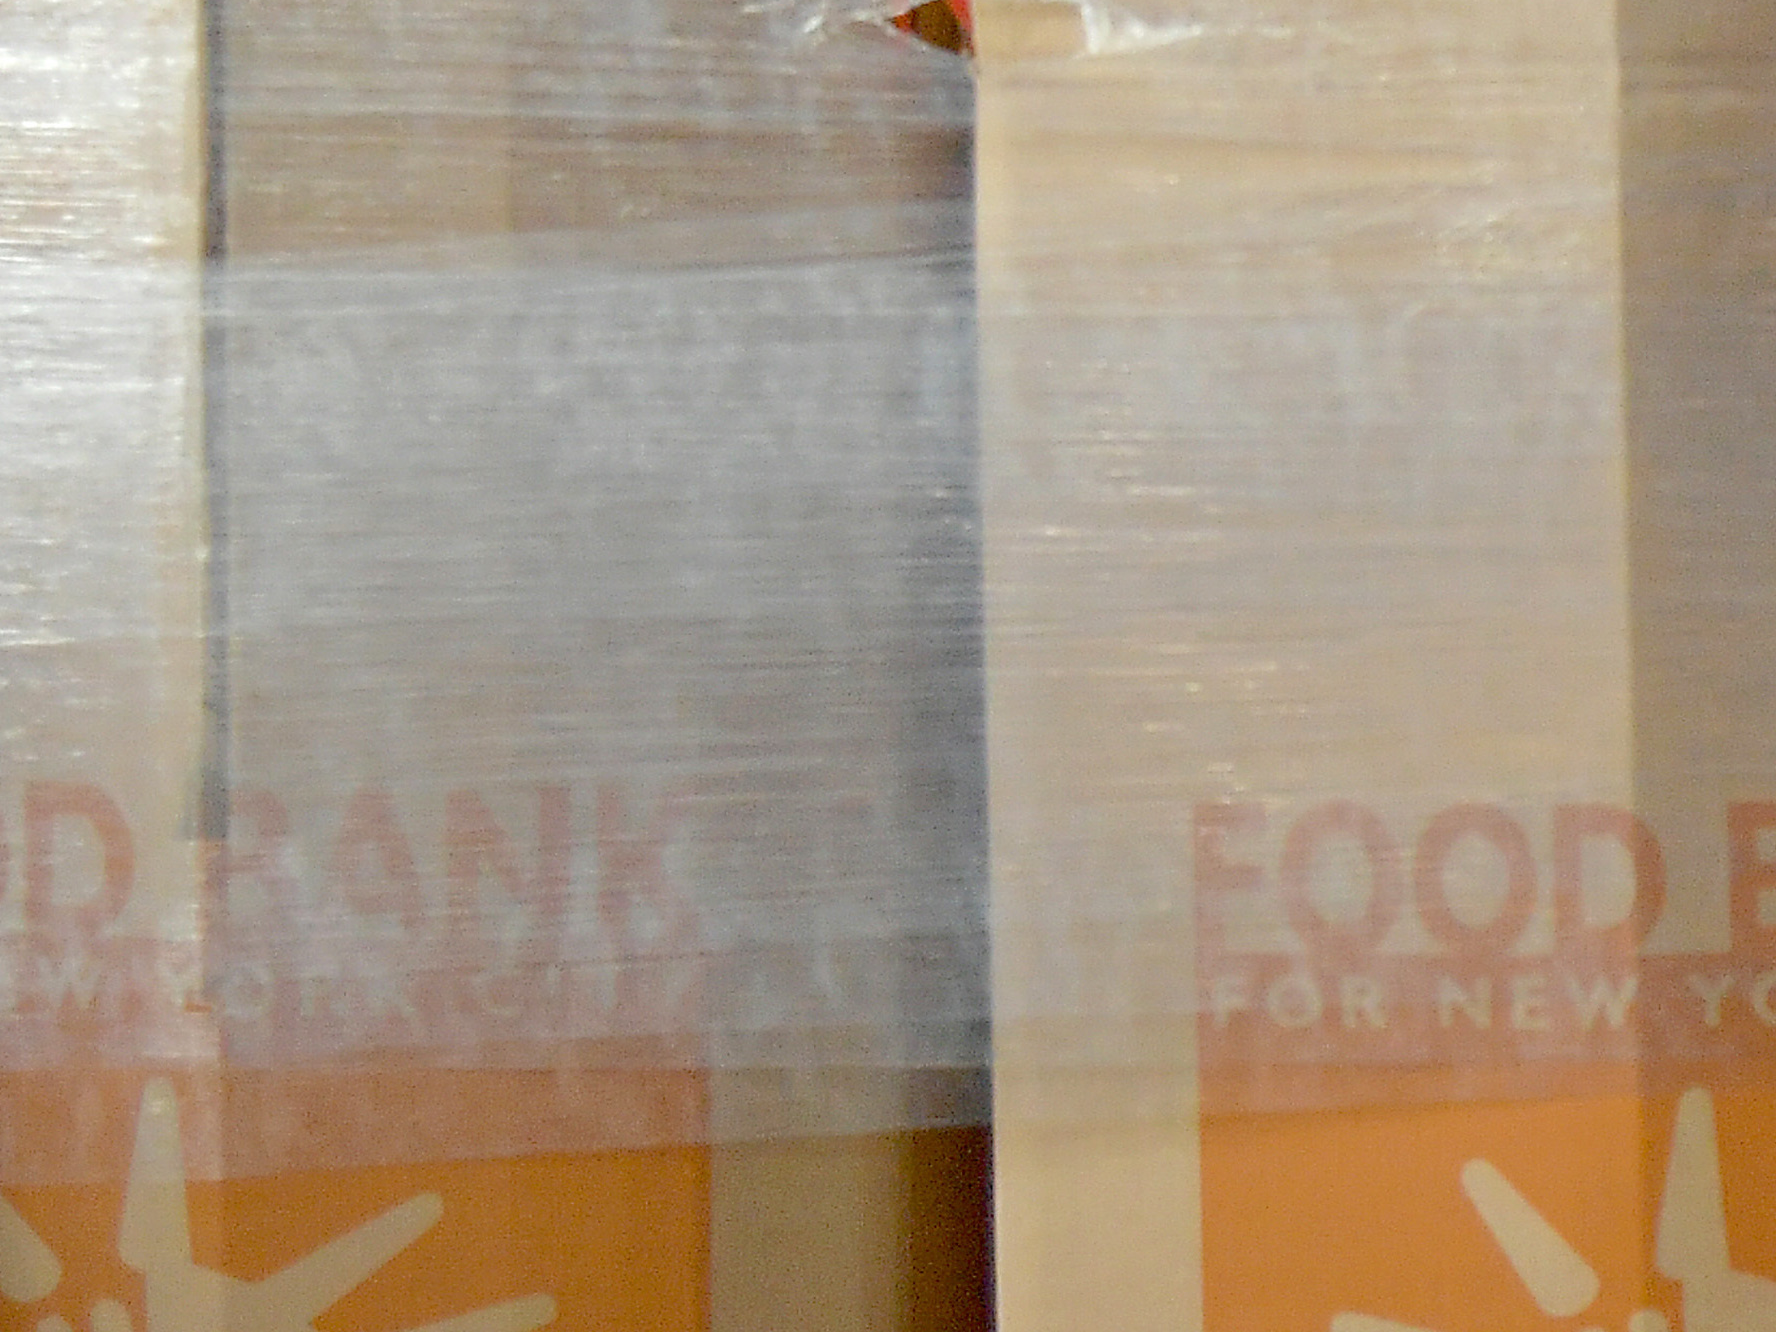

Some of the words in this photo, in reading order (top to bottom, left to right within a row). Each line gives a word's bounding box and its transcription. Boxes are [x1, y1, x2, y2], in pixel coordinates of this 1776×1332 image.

[0, 780, 136, 943] D
[199, 774, 705, 946] BANK
[1194, 799, 1667, 956] FOOD
[1211, 971, 1387, 1030] FOR
[1436, 973, 1640, 1032] NEW
